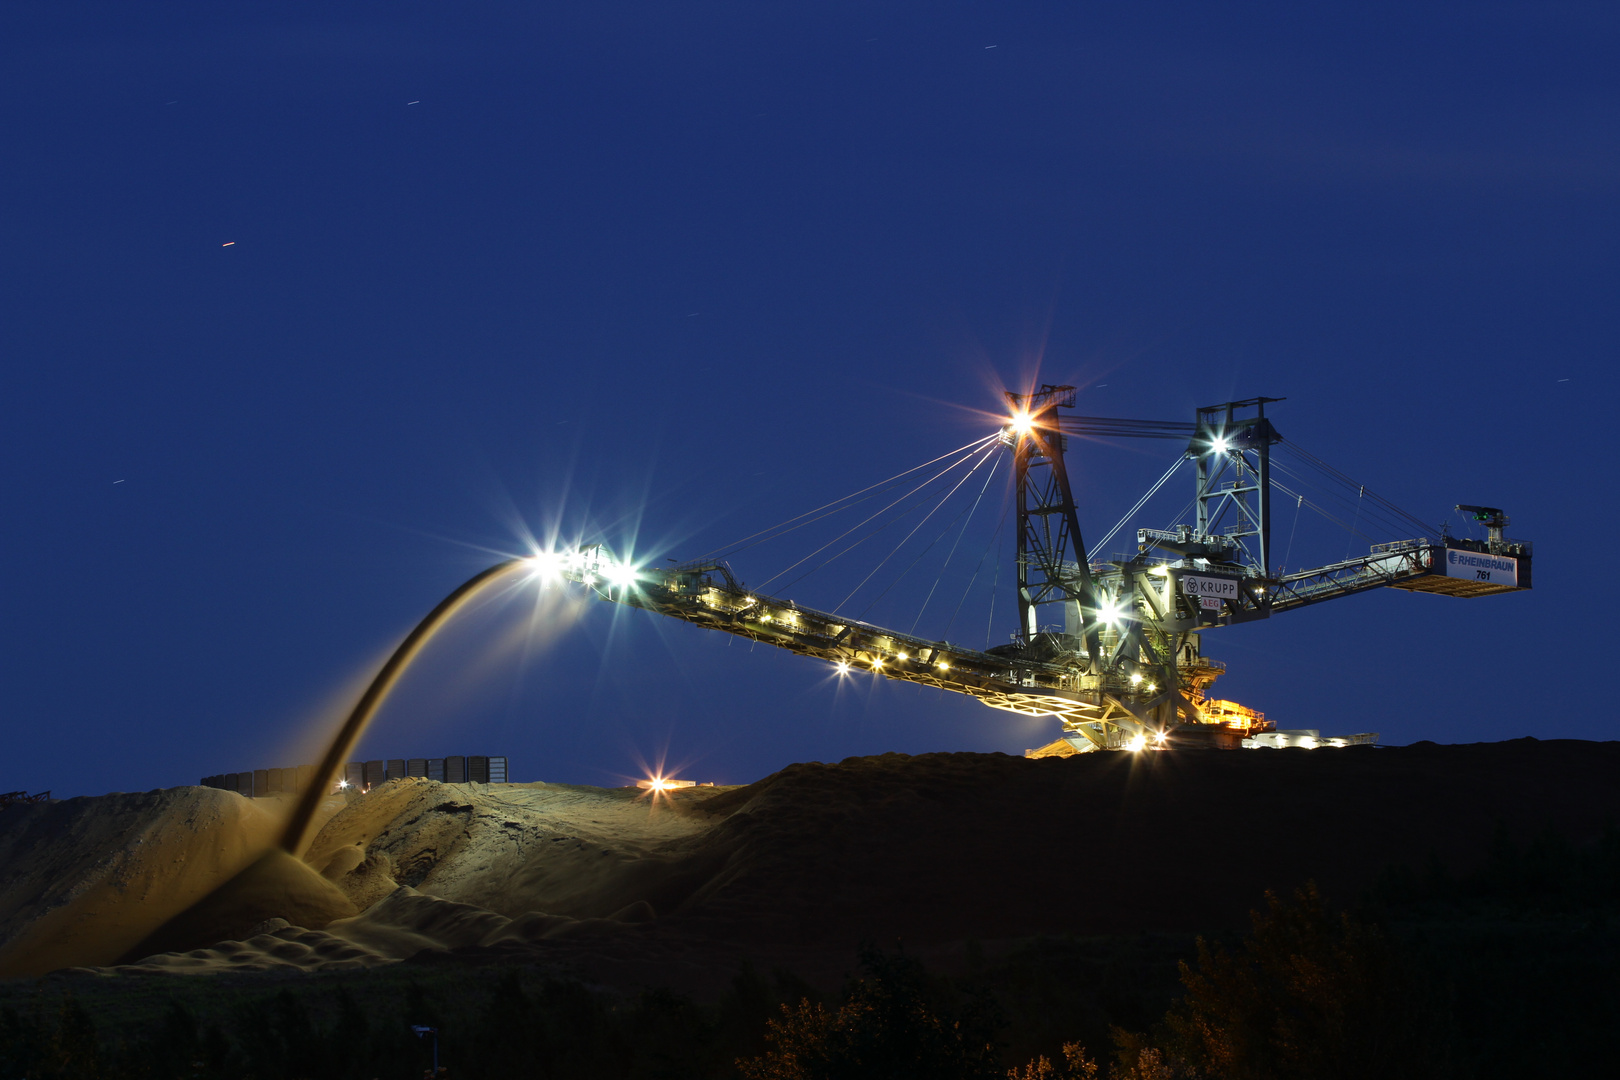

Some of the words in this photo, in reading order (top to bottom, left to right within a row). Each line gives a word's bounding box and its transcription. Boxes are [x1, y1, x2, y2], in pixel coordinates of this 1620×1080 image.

[1458, 555, 1514, 572] RHEINBRAUN
[1476, 570, 1491, 580] 761
[1200, 581, 1235, 594] KRUPP
[1202, 599, 1219, 607] AEG
